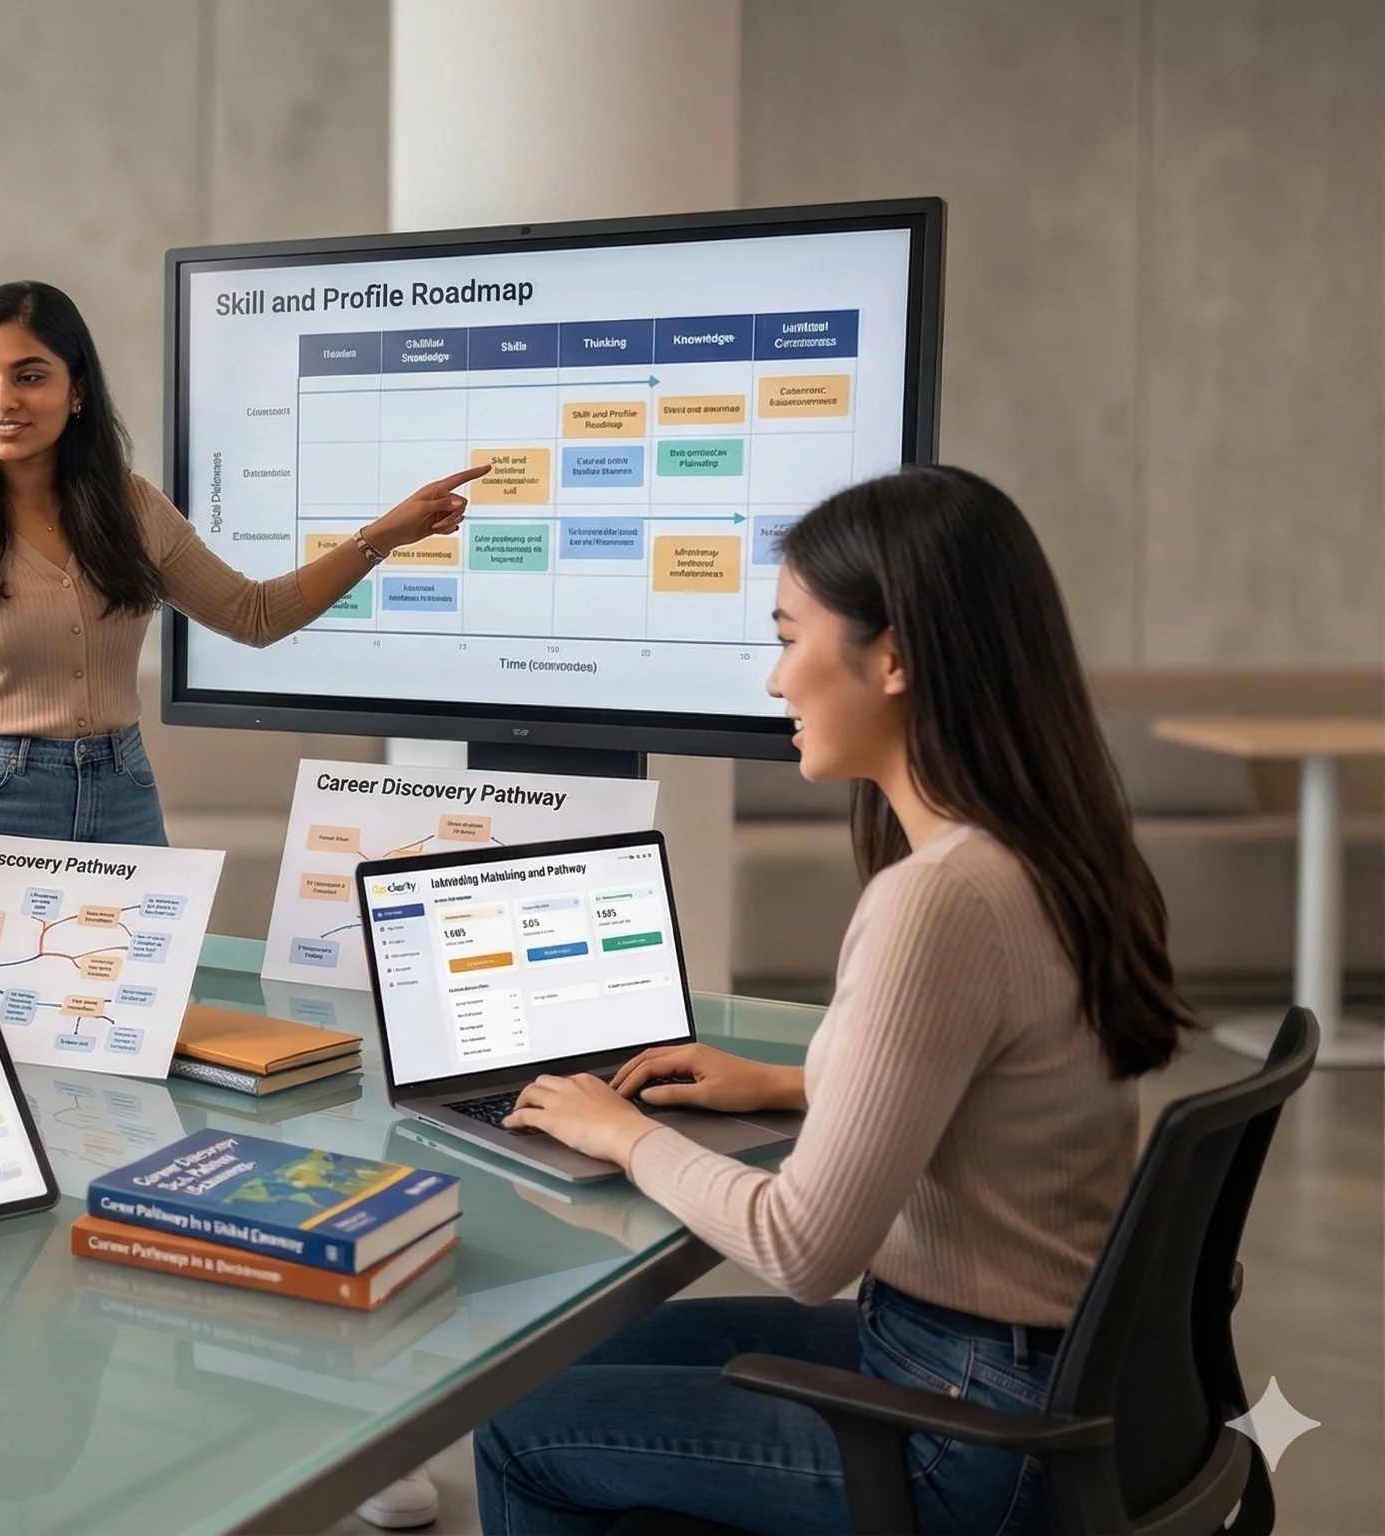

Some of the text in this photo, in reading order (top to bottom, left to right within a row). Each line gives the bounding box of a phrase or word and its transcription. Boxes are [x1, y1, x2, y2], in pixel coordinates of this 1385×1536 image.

[215, 278, 534, 316] Skill and Profile Roadmap
[499, 657, 527, 670] Time
[316, 772, 568, 811] Career Discovery Pathway
[64, 856, 138, 881] Pathway
[528, 866, 546, 879] and
[547, 863, 587, 878] Pathway
